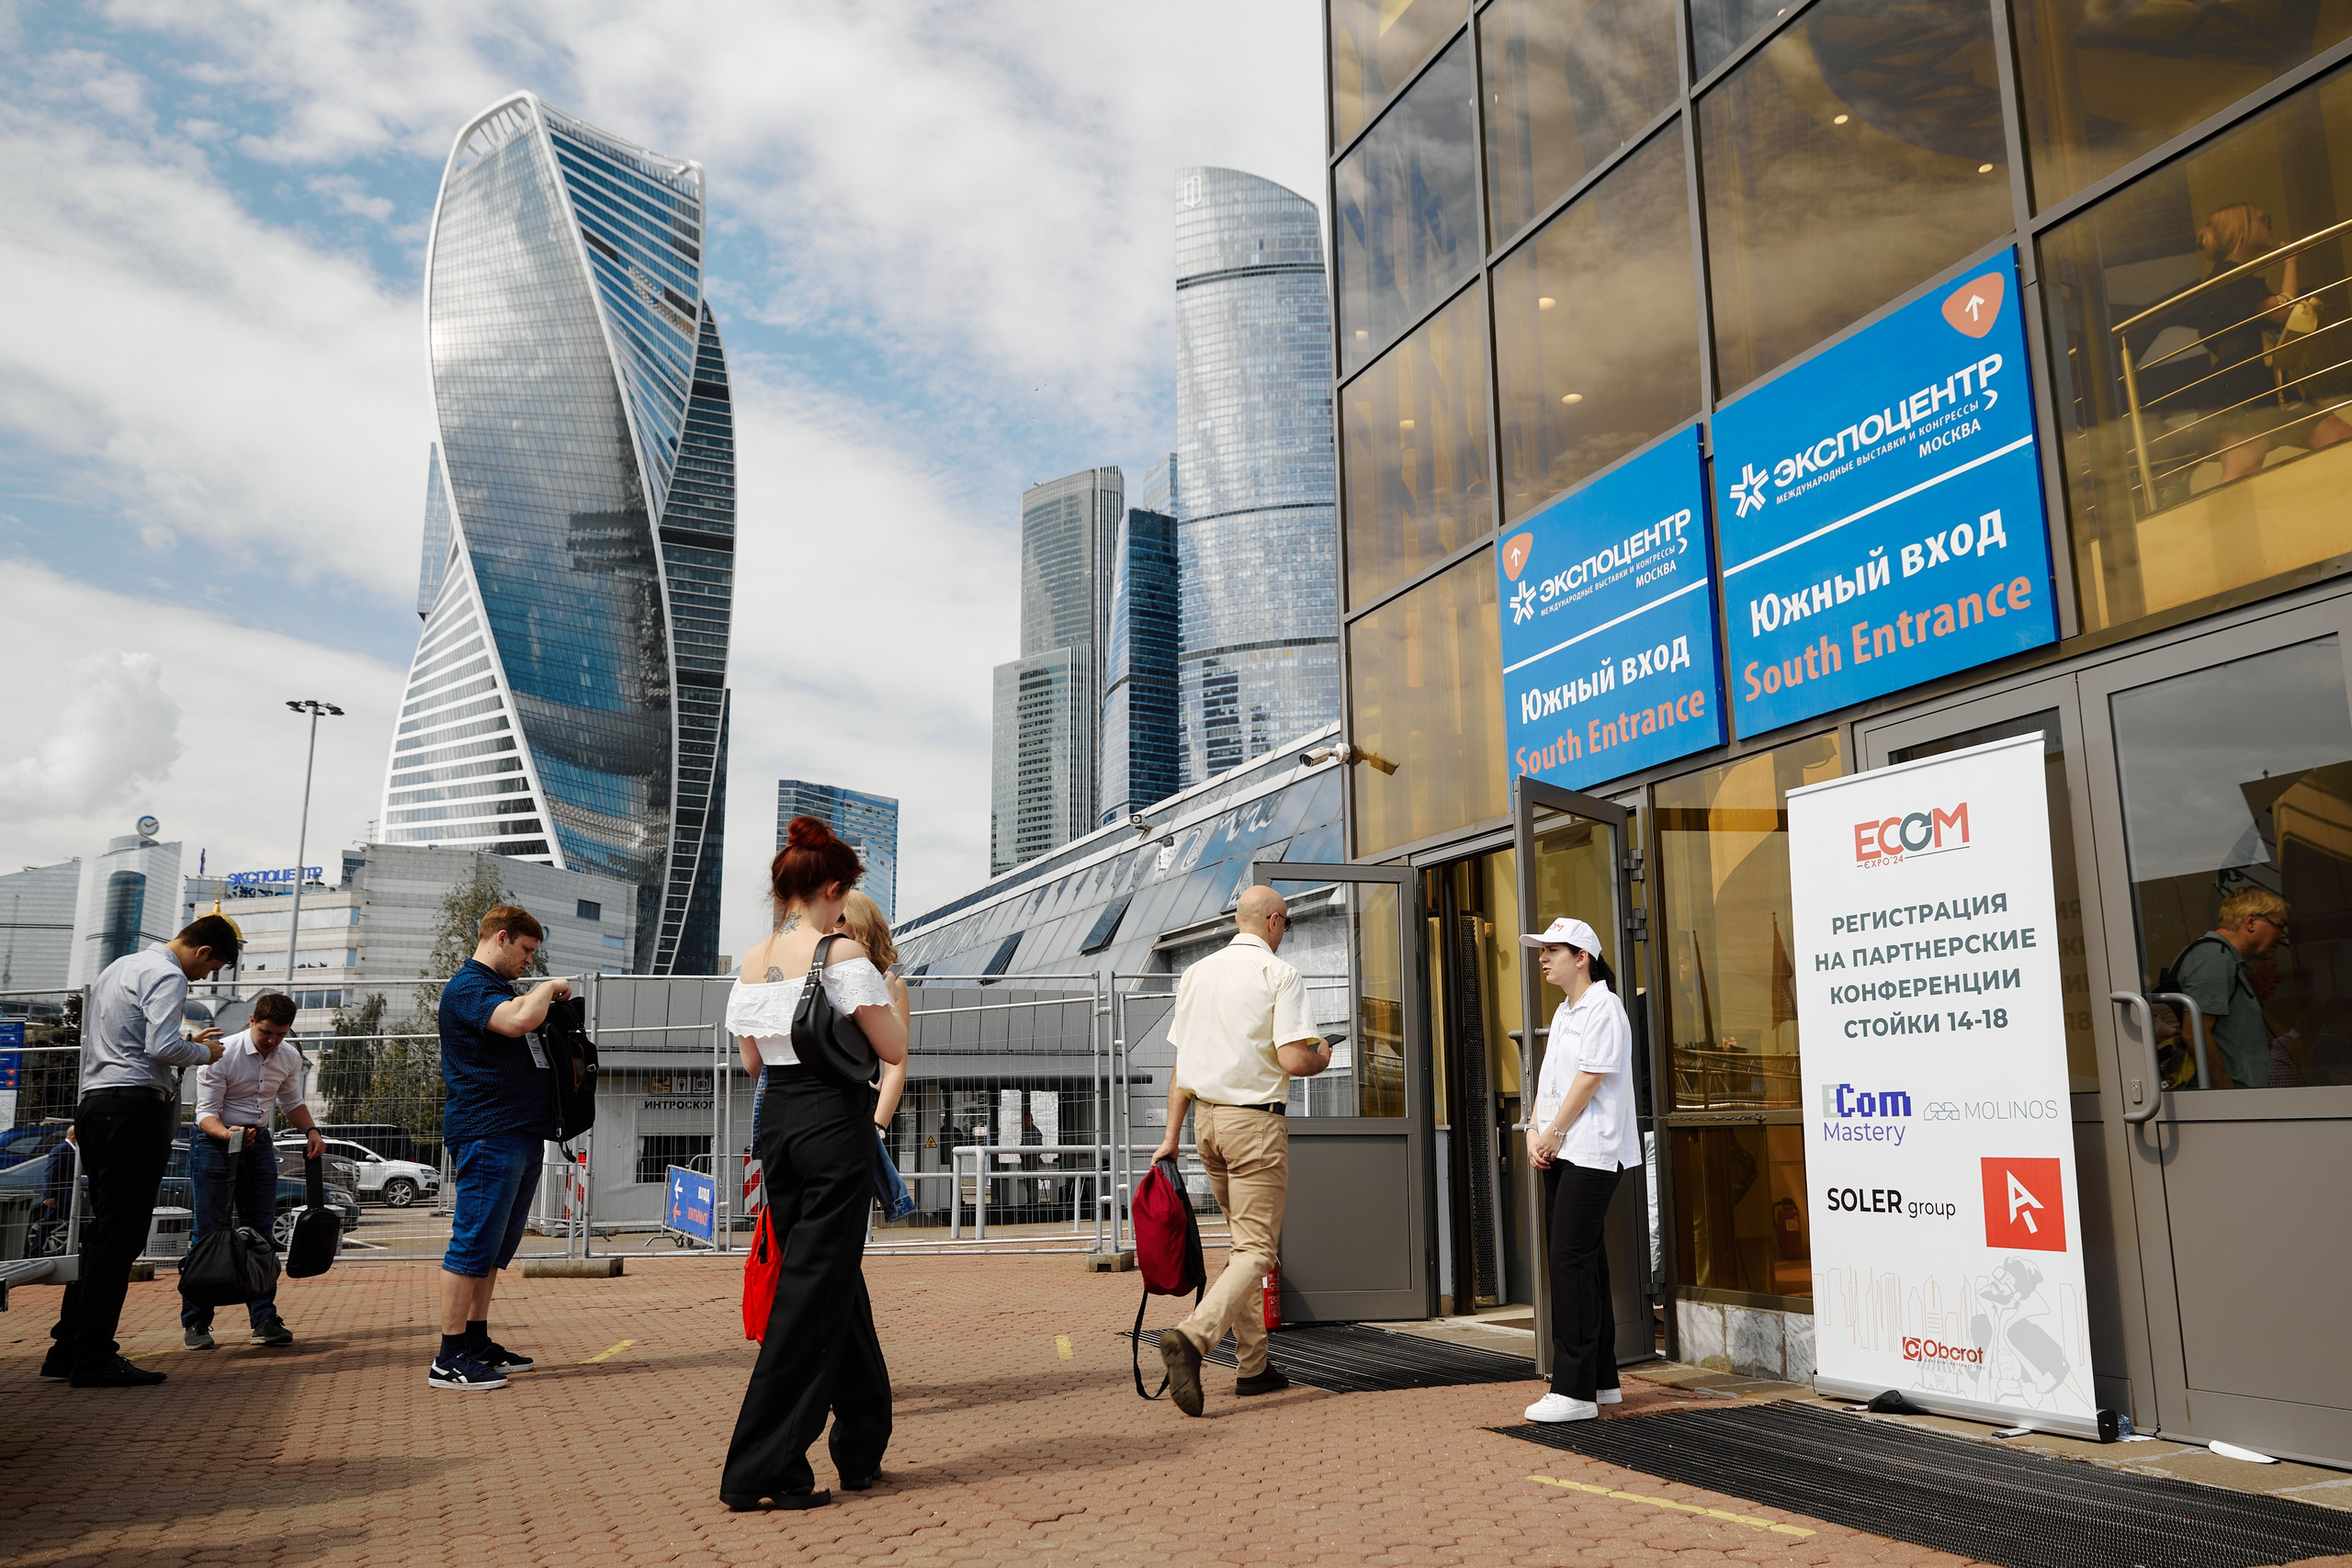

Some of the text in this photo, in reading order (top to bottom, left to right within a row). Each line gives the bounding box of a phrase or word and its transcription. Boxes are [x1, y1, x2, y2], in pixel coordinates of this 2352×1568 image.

[1774, 354, 2003, 488] ЭКСПОЦЕНТР
[1918, 418, 1982, 458] МОСКВА
[1776, 400, 1979, 505] МЕЖДУНАРОДНЫЕ ВЫСТАВКИ И КОНГРЕССЫ
[1539, 509, 1691, 603] ЭКСПОЦЕНТР
[1635, 560, 1677, 588] МОСКВА
[1540, 546, 1675, 616] МЕЖДУНАРОДНЫЕ ВЫСТАВКИ И КОНГРЕССЫ
[1750, 546, 1890, 637] Южный
[1744, 576, 2031, 702] South Entrance
[1521, 659, 1615, 724] Южный
[1516, 690, 1705, 778] South Entrance
[1854, 802, 1970, 863] ECOM
[226, 866, 322, 886] ЭКСПОЦЕТР
[1832, 893, 2007, 935] РЕГИСТРАЦИЯ
[1815, 951, 1846, 972] НА
[1852, 928, 2037, 967] ПАРТНЕРСКИЕ
[1830, 968, 2020, 1005] КОНФЕРЕНЦИИ
[1844, 1008, 2008, 1039] СТОЙКИ 14-18
[1964, 1100, 2058, 1121] MOLINOS
[1824, 1122, 1906, 1146] Mastery
[1827, 1188, 1956, 1220] SOLER group
